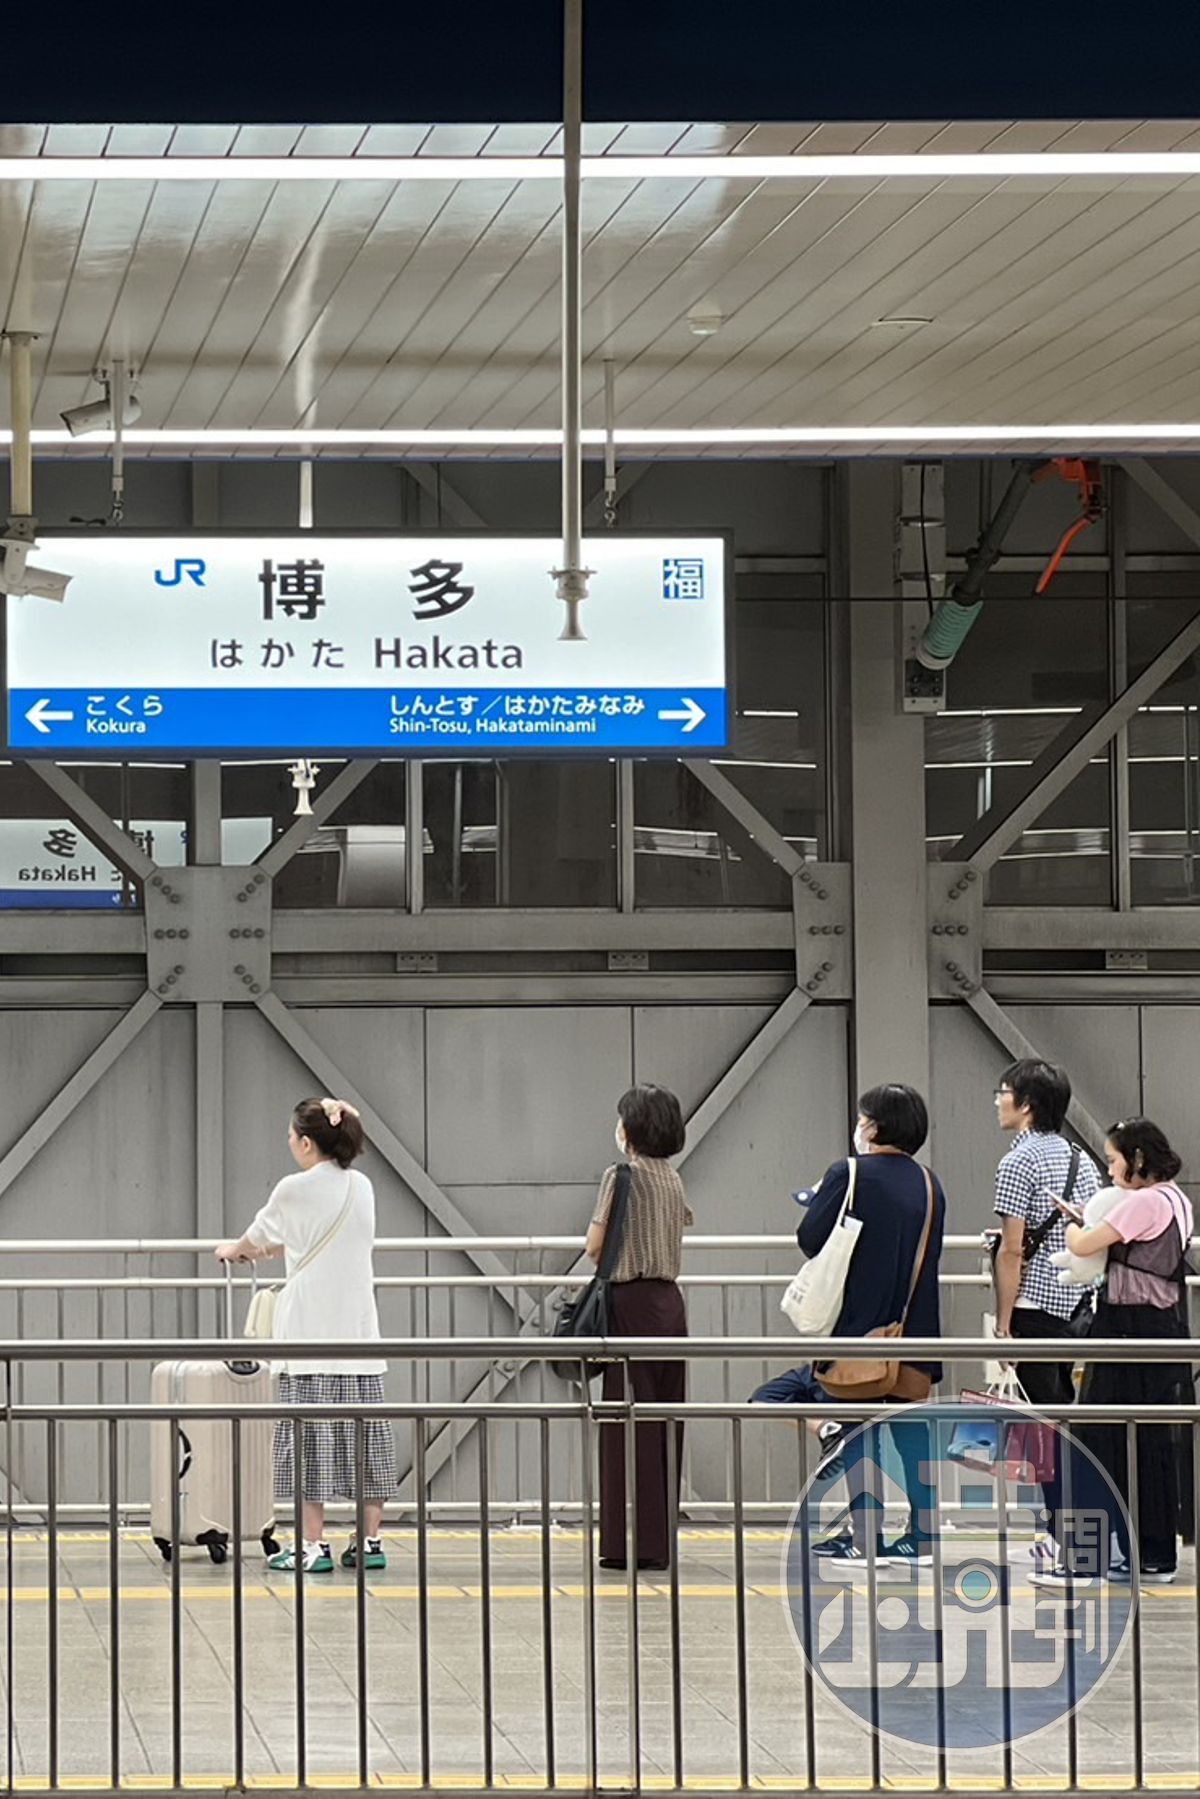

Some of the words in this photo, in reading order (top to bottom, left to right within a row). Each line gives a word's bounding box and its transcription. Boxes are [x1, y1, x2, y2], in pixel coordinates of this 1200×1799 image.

[155, 558, 206, 587] JR
[662, 558, 704, 600] 福
[259, 558, 475, 620] 博多
[211, 638, 345, 669] はかた
[374, 636, 523, 669] Hakata
[86, 695, 163, 716] こくら
[86, 718, 146, 733] Kokura
[390, 717, 472, 735] Shin-Tosu,
[476, 717, 597, 733] Hakataminami
